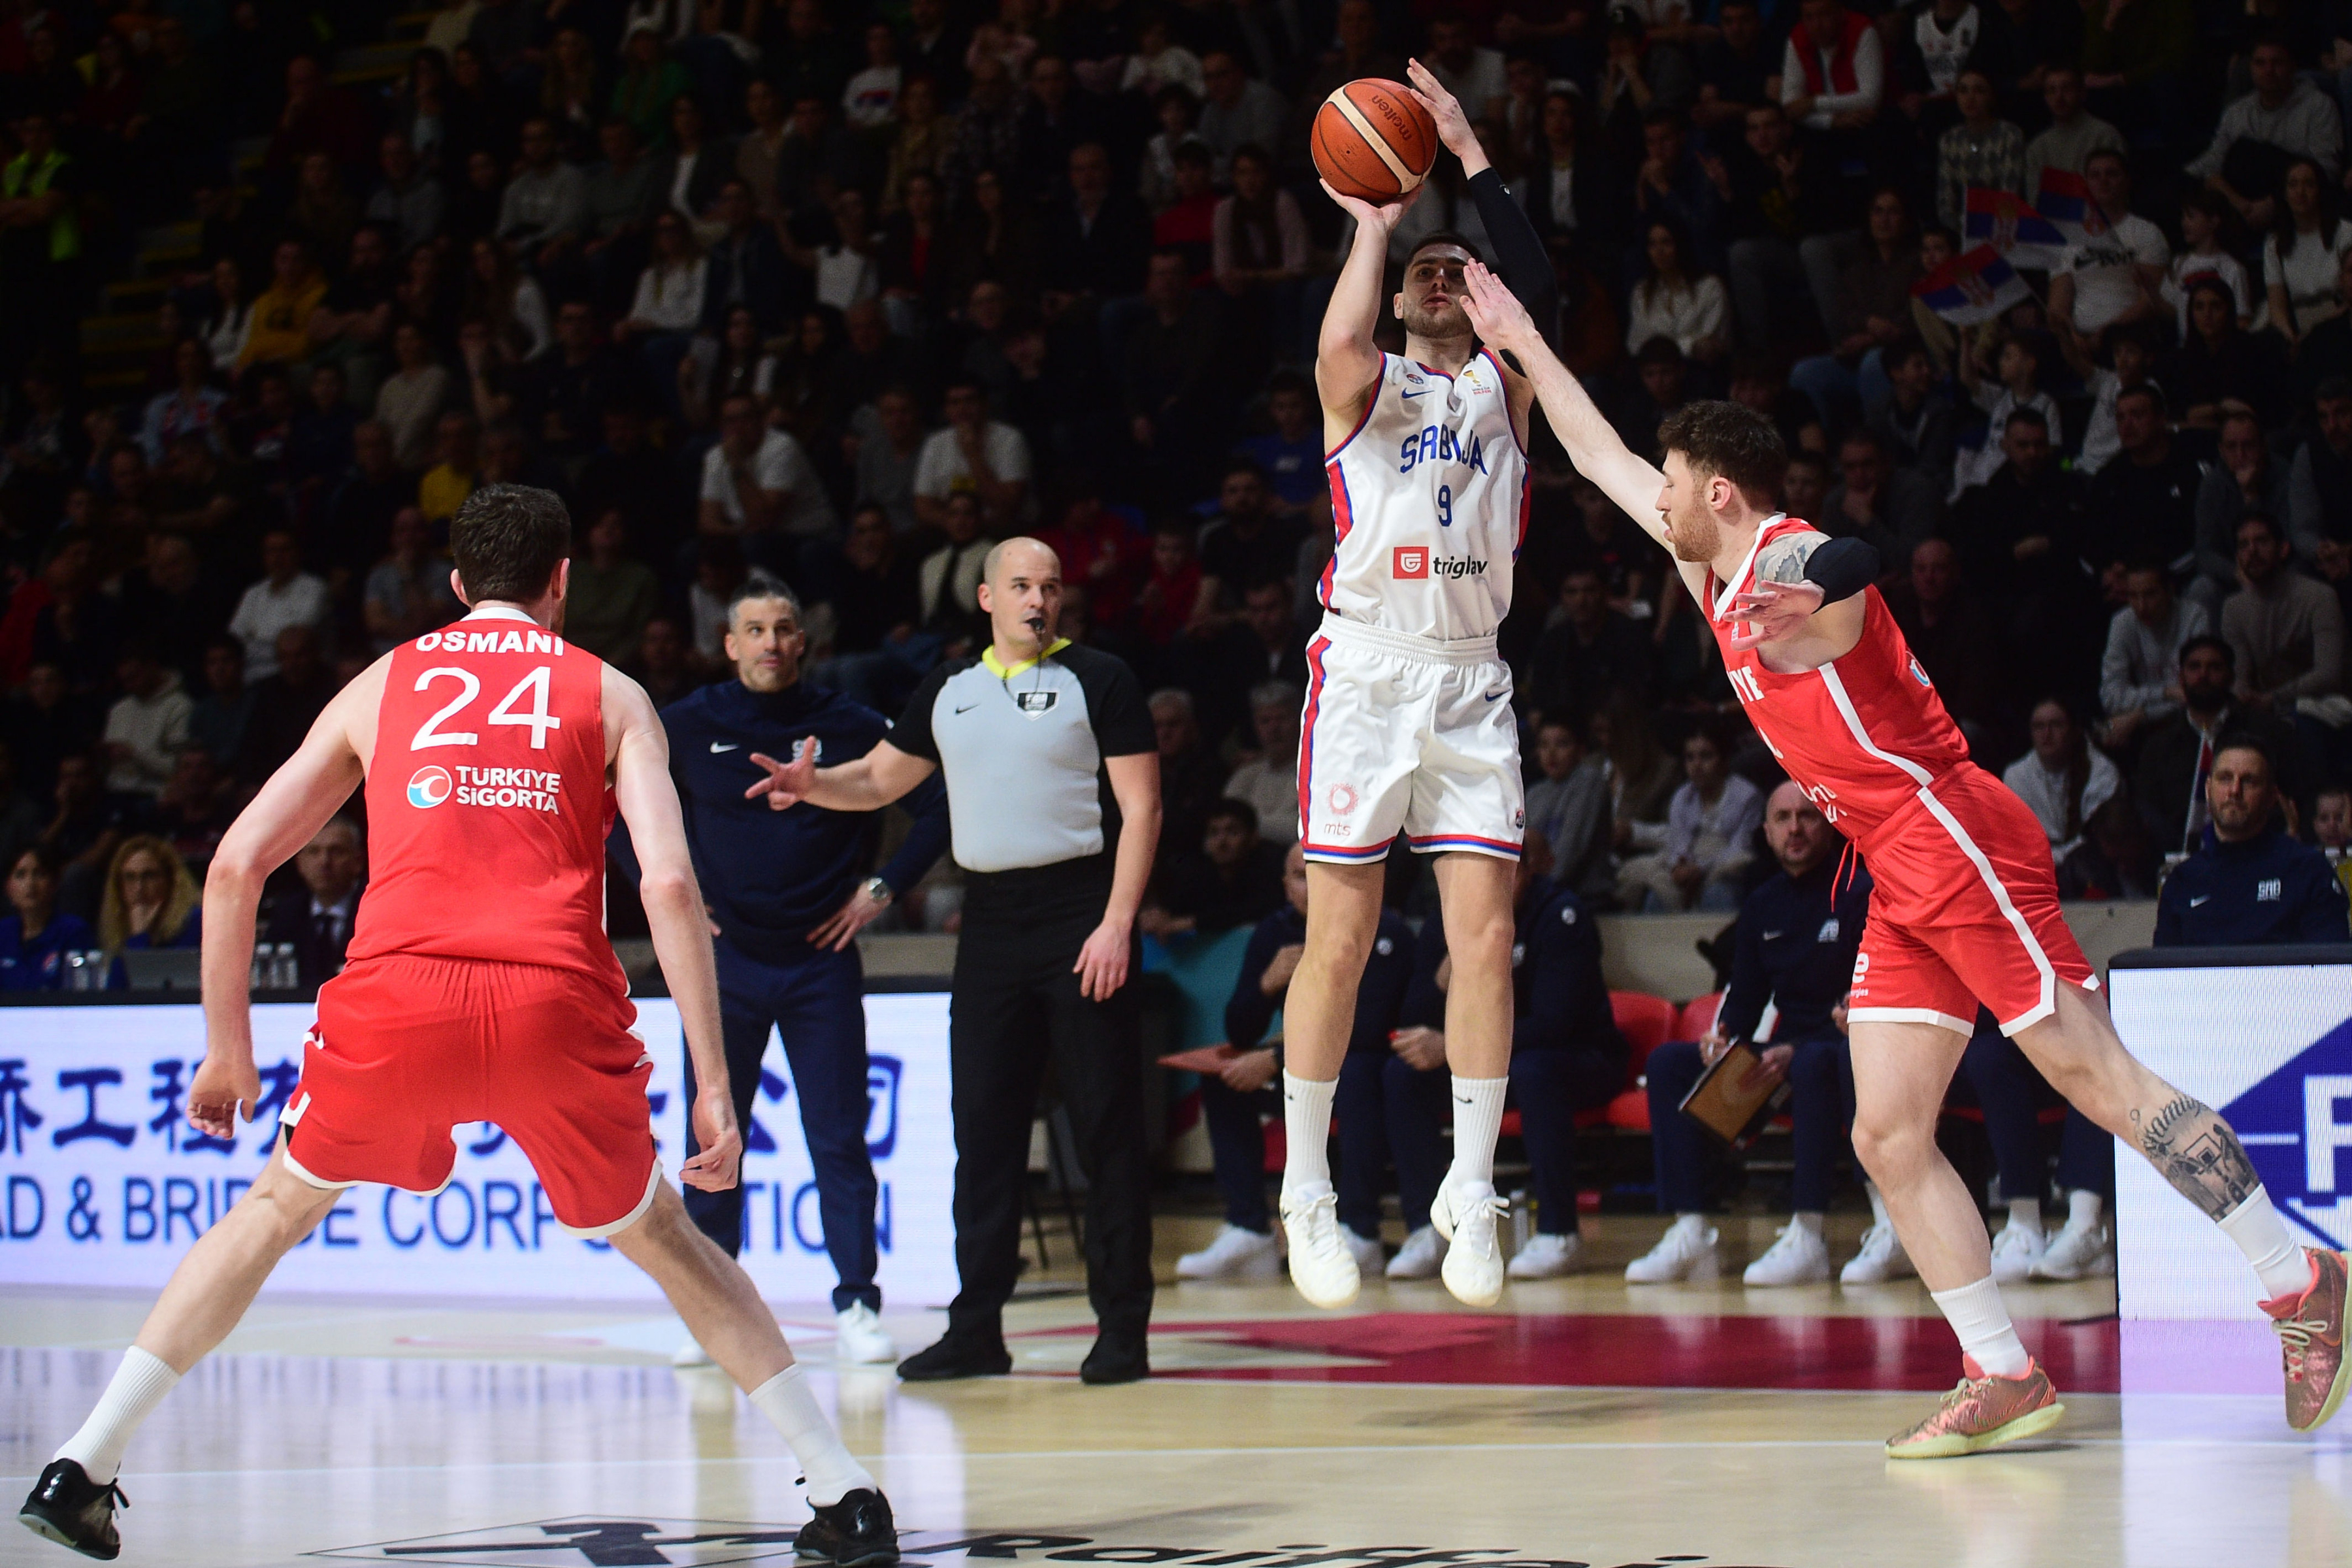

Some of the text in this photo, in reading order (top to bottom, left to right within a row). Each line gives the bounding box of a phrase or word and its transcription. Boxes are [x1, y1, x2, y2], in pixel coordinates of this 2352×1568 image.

[1371, 95, 1412, 141] molten
[1400, 424, 1488, 476] SRBIJA
[1438, 485, 1452, 527] 9
[1433, 555, 1488, 579] triglav
[410, 666, 561, 751] 24
[1324, 822, 1351, 836] mts
[67, 1177, 101, 1241] &
[124, 1178, 358, 1245] BRIE
